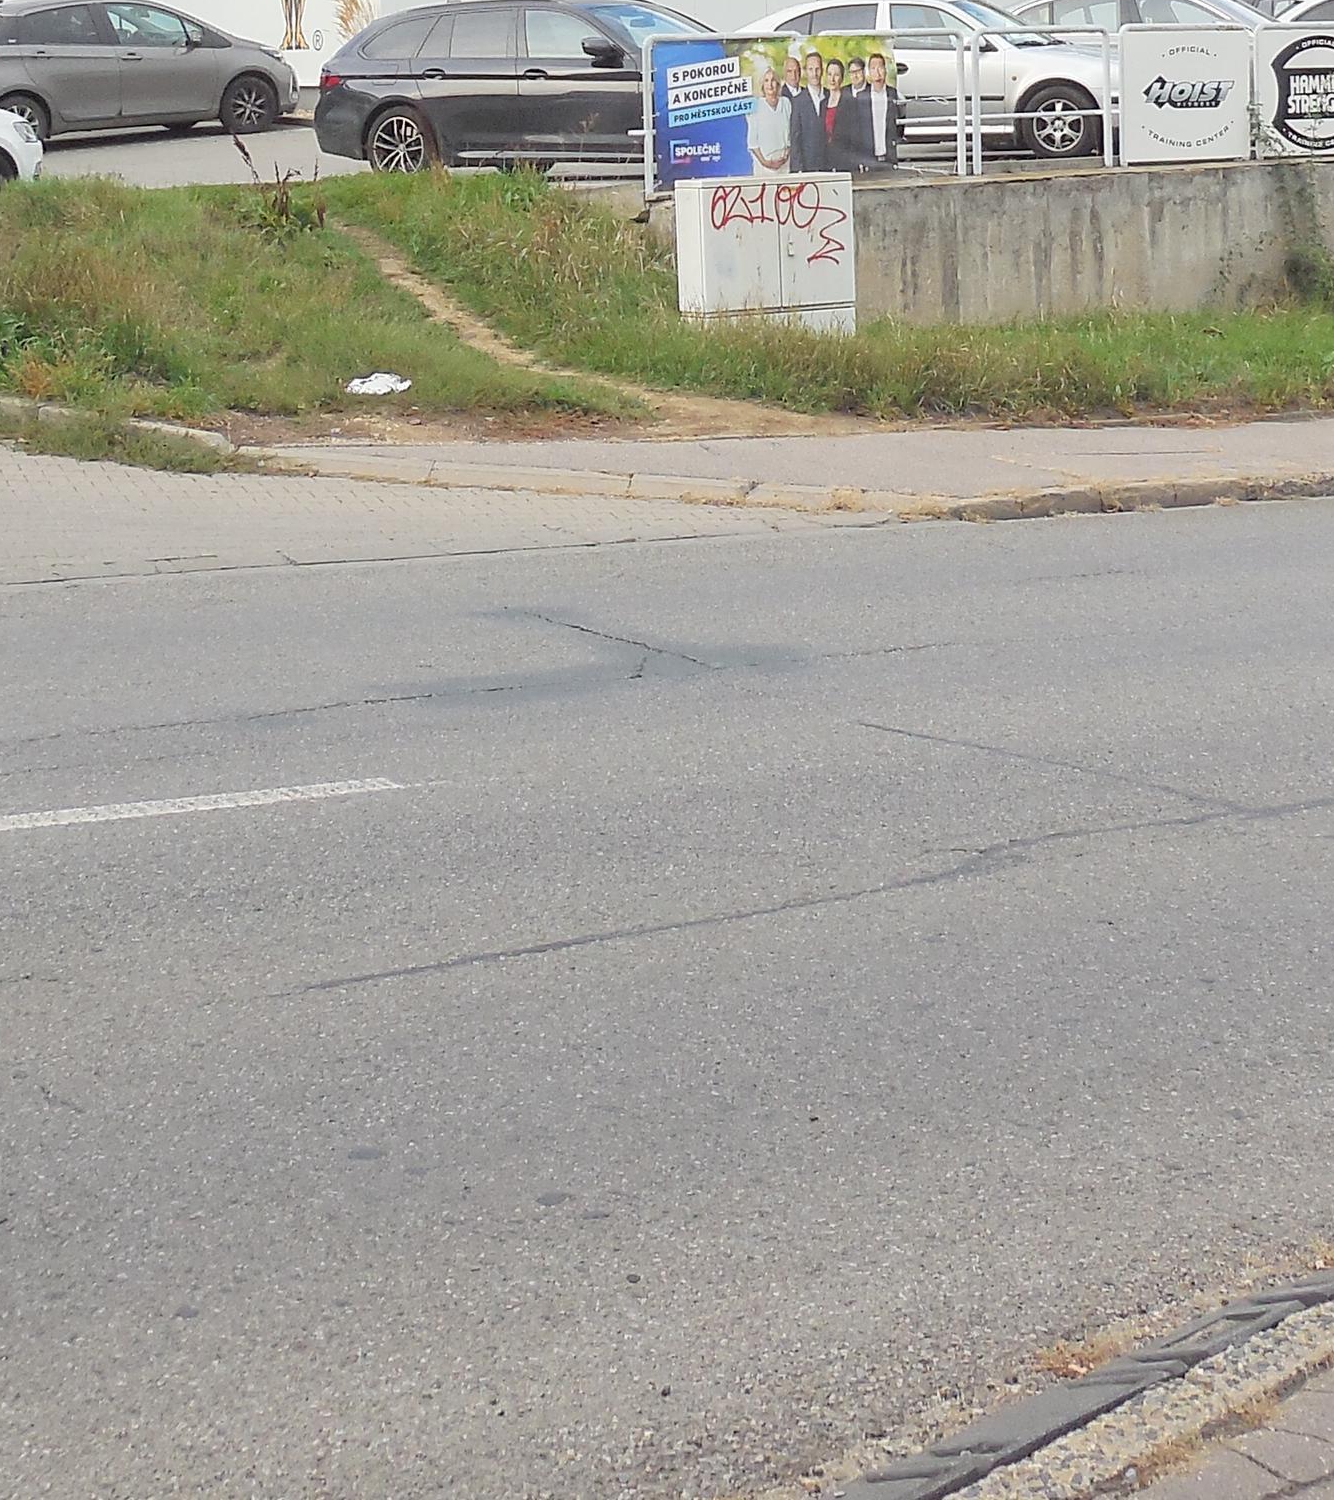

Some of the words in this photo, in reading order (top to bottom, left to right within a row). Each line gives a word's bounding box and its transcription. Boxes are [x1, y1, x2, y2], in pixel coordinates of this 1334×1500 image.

[1169, 46, 1210, 56] OFFICIAL
[672, 72, 679, 83] S
[682, 62, 735, 81] POKOROU
[672, 94, 681, 105] A
[684, 79, 748, 102] KONCEPČNĚ
[1146, 80, 1235, 103] HOIST
[673, 113, 689, 123] PRO
[1148, 129, 1193, 148] TRAINING
[1195, 125, 1229, 147] CENTER
